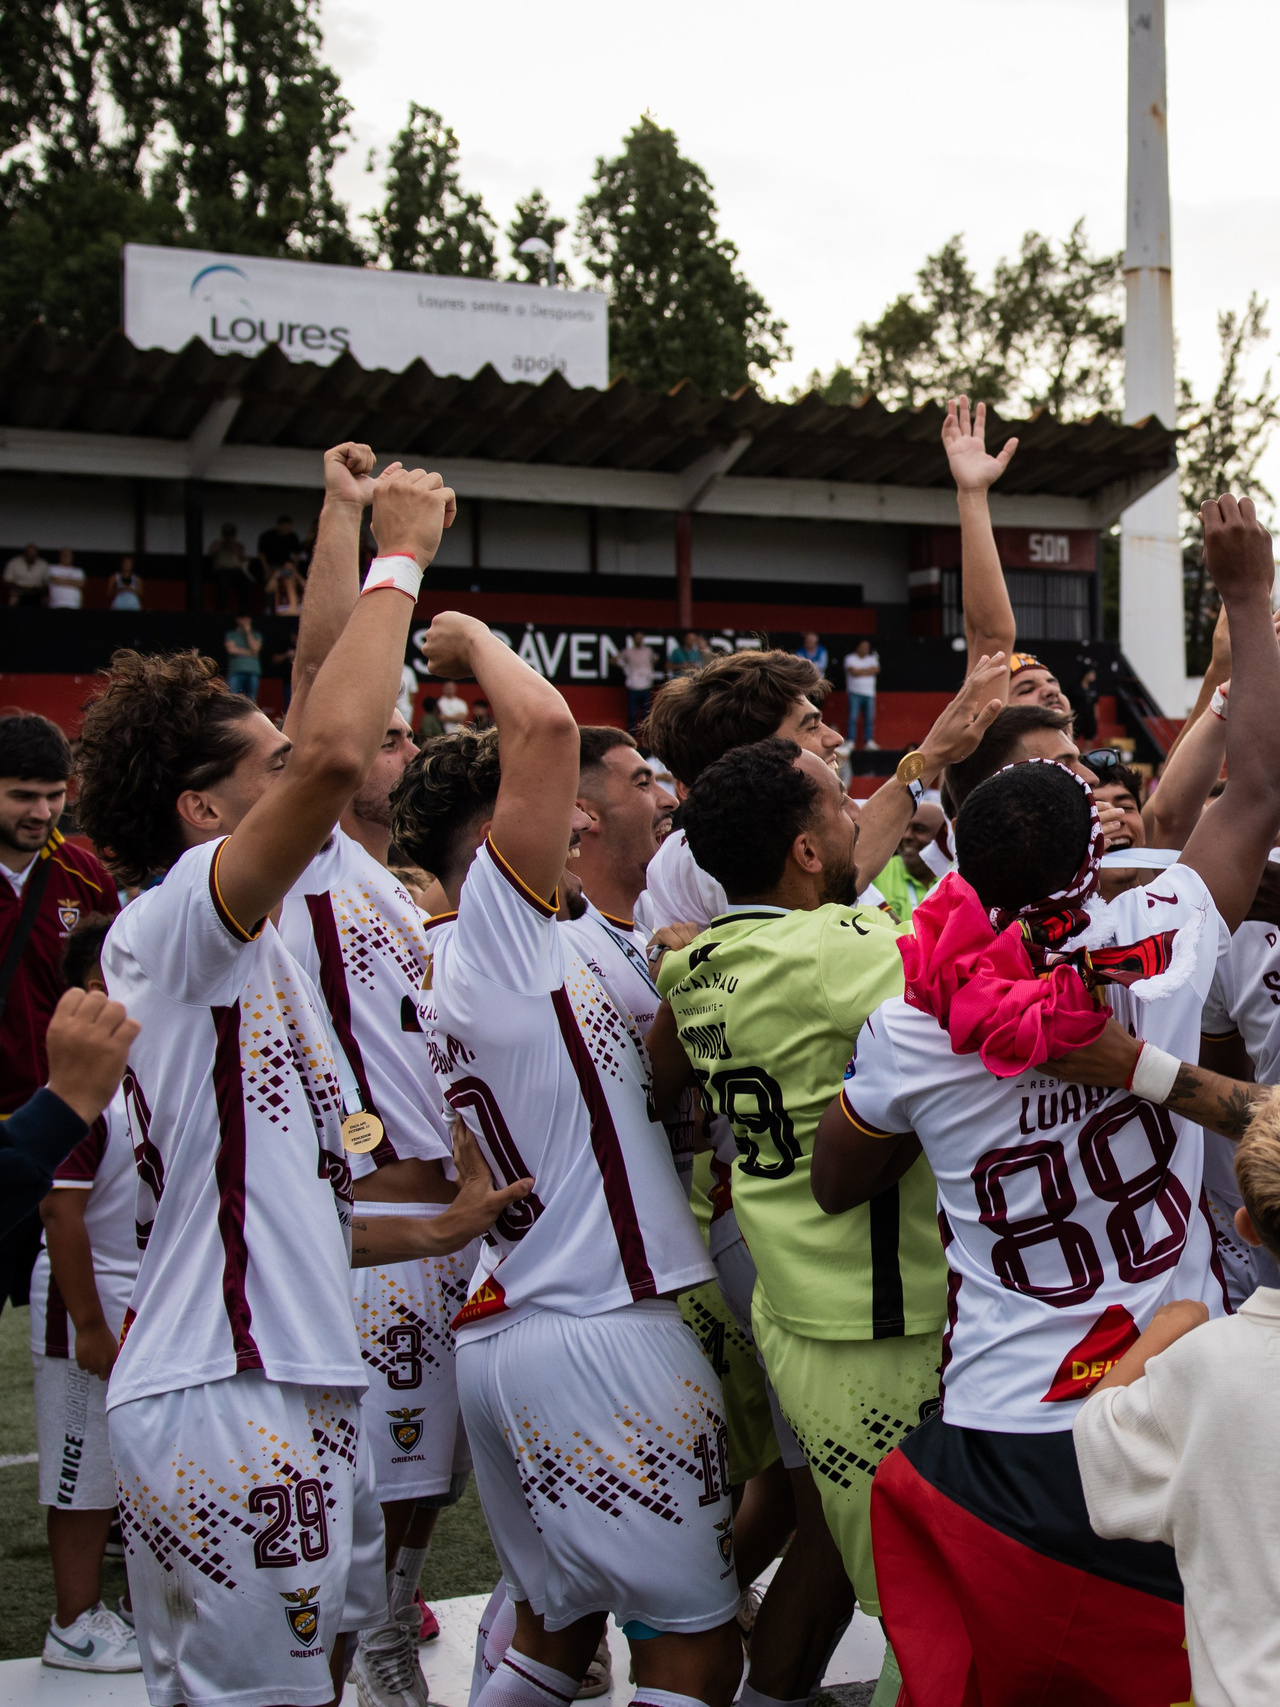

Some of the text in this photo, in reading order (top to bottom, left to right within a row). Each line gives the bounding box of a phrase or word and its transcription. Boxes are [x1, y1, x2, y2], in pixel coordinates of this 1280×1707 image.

[417, 293, 466, 309] Loures
[211, 314, 351, 353] Loures
[970, 1096, 1192, 1309] 88
[386, 1324, 423, 1391] 3
[1072, 1360, 1119, 1380] DEL
[57, 1366, 90, 1506] VENICE BEACH
[391, 1454, 426, 1464] ORIENTAL
[248, 1478, 330, 1570] 29
